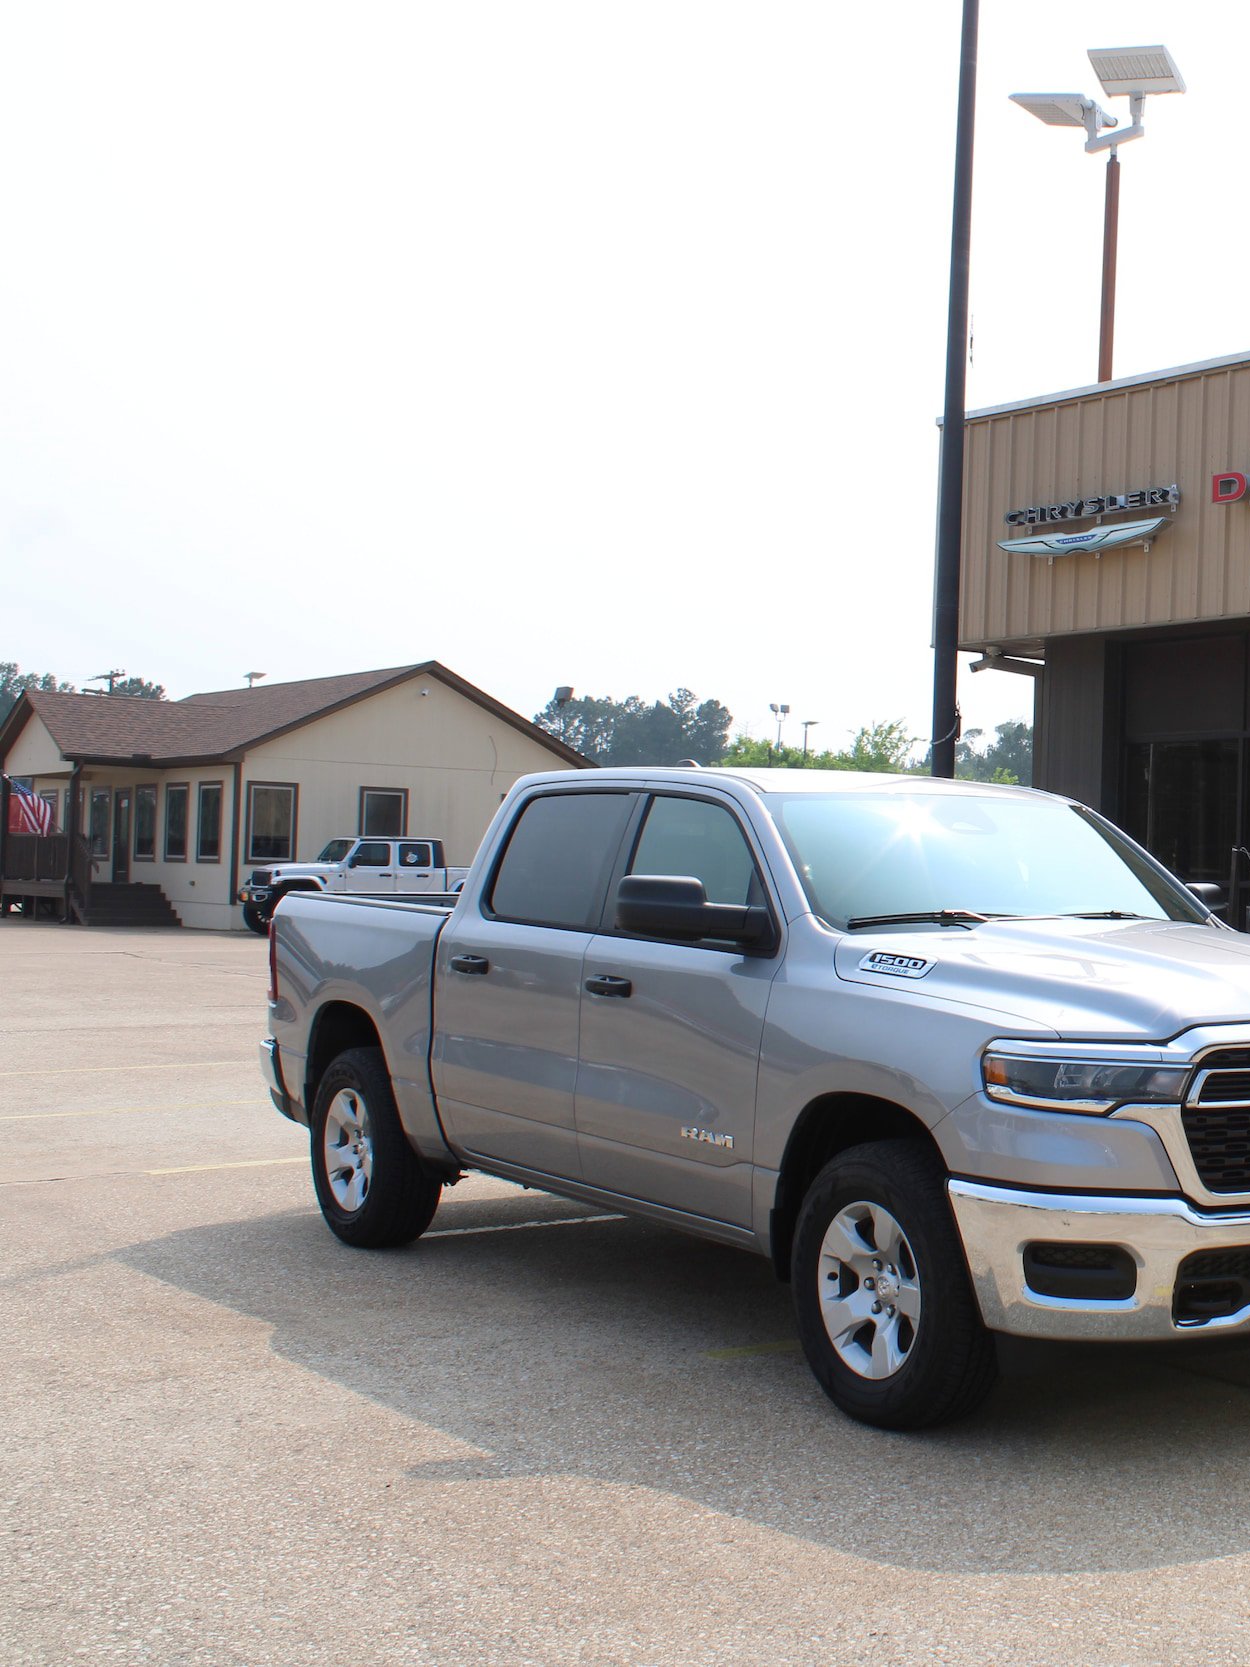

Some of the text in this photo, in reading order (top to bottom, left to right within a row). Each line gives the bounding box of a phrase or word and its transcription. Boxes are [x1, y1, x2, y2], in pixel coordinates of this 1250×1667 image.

[1004, 487, 1171, 527] CHRYSLER
[873, 953, 925, 970] 1500
[680, 1126, 735, 1149] RAM
